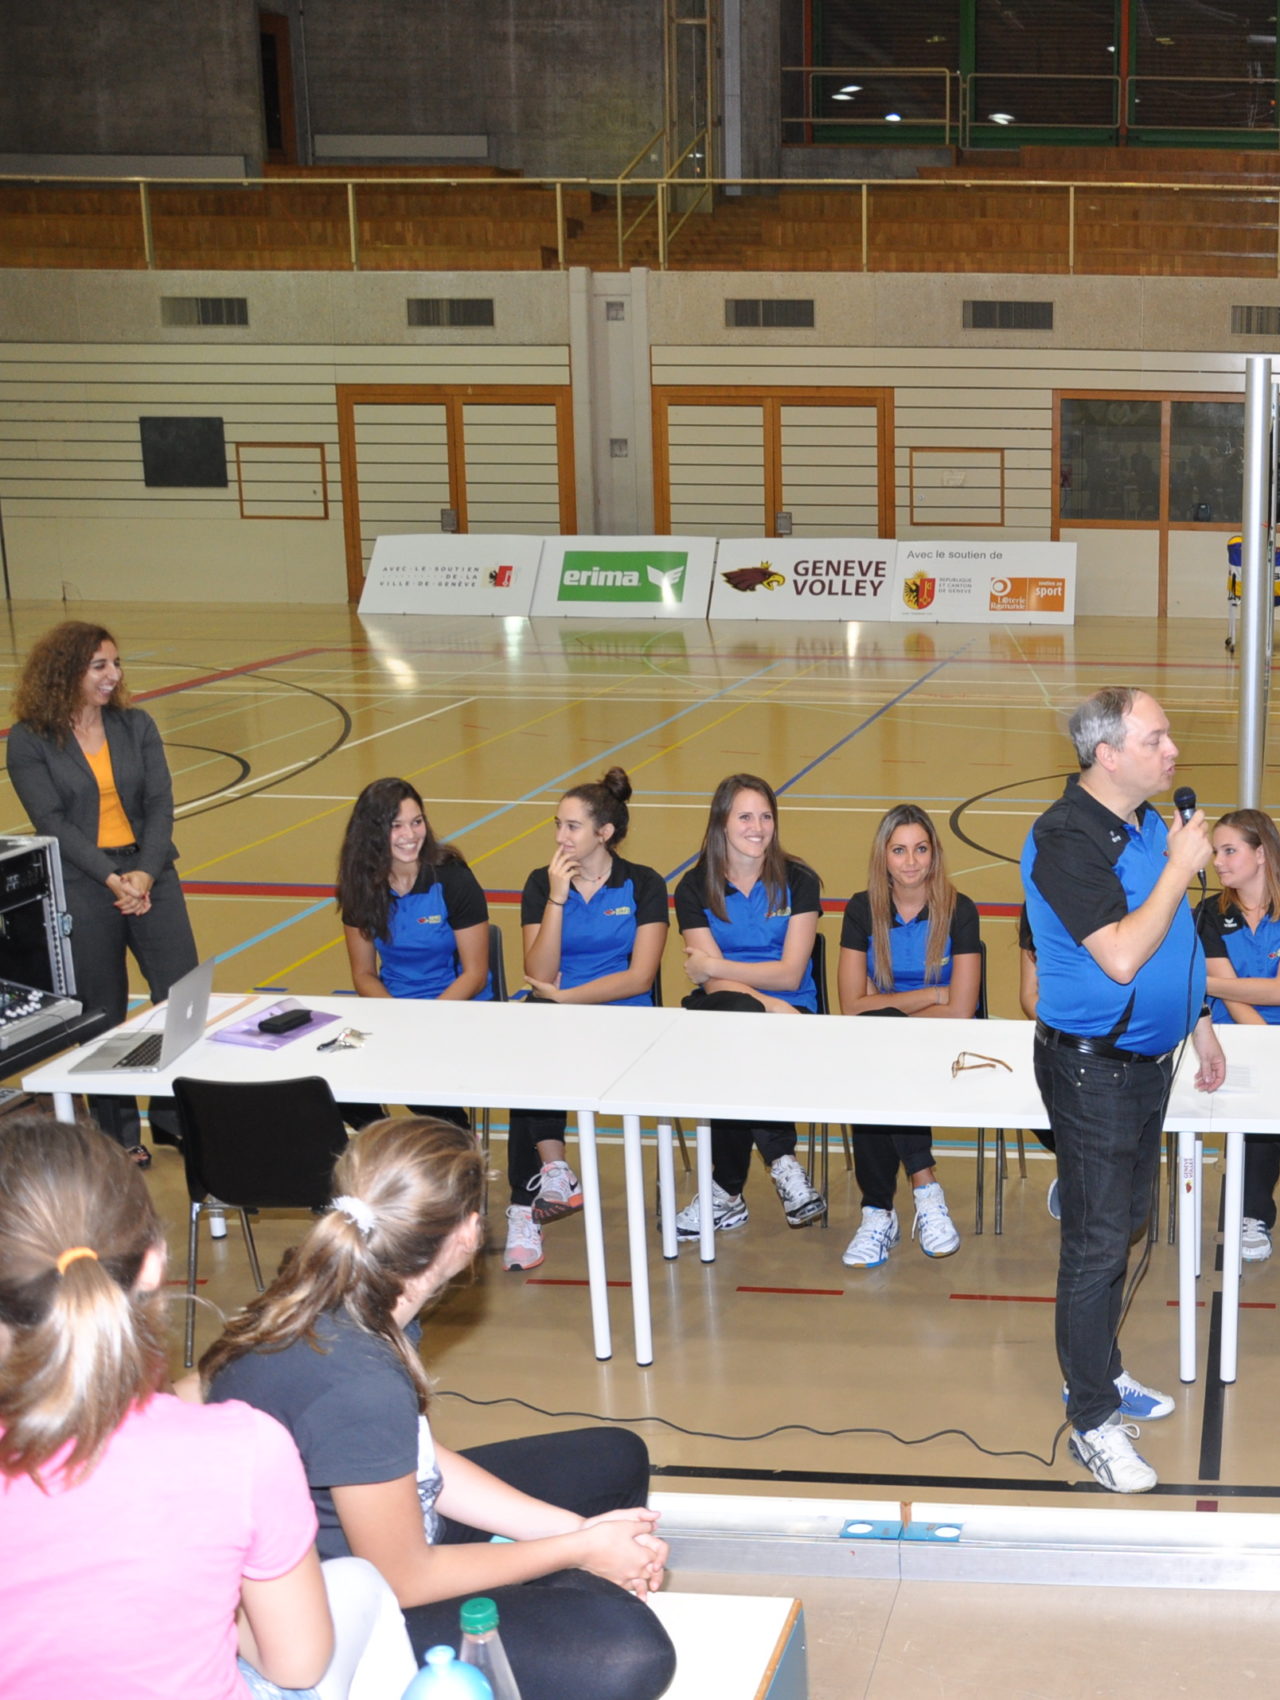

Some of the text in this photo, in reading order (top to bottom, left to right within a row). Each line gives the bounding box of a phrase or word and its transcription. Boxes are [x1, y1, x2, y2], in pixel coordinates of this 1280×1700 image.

[907, 549, 1003, 560] Avec le soutien de
[563, 566, 640, 587] erima
[793, 559, 887, 578] GENEVE
[792, 578, 884, 597] VOLLEY
[1035, 587, 1062, 598] sport
